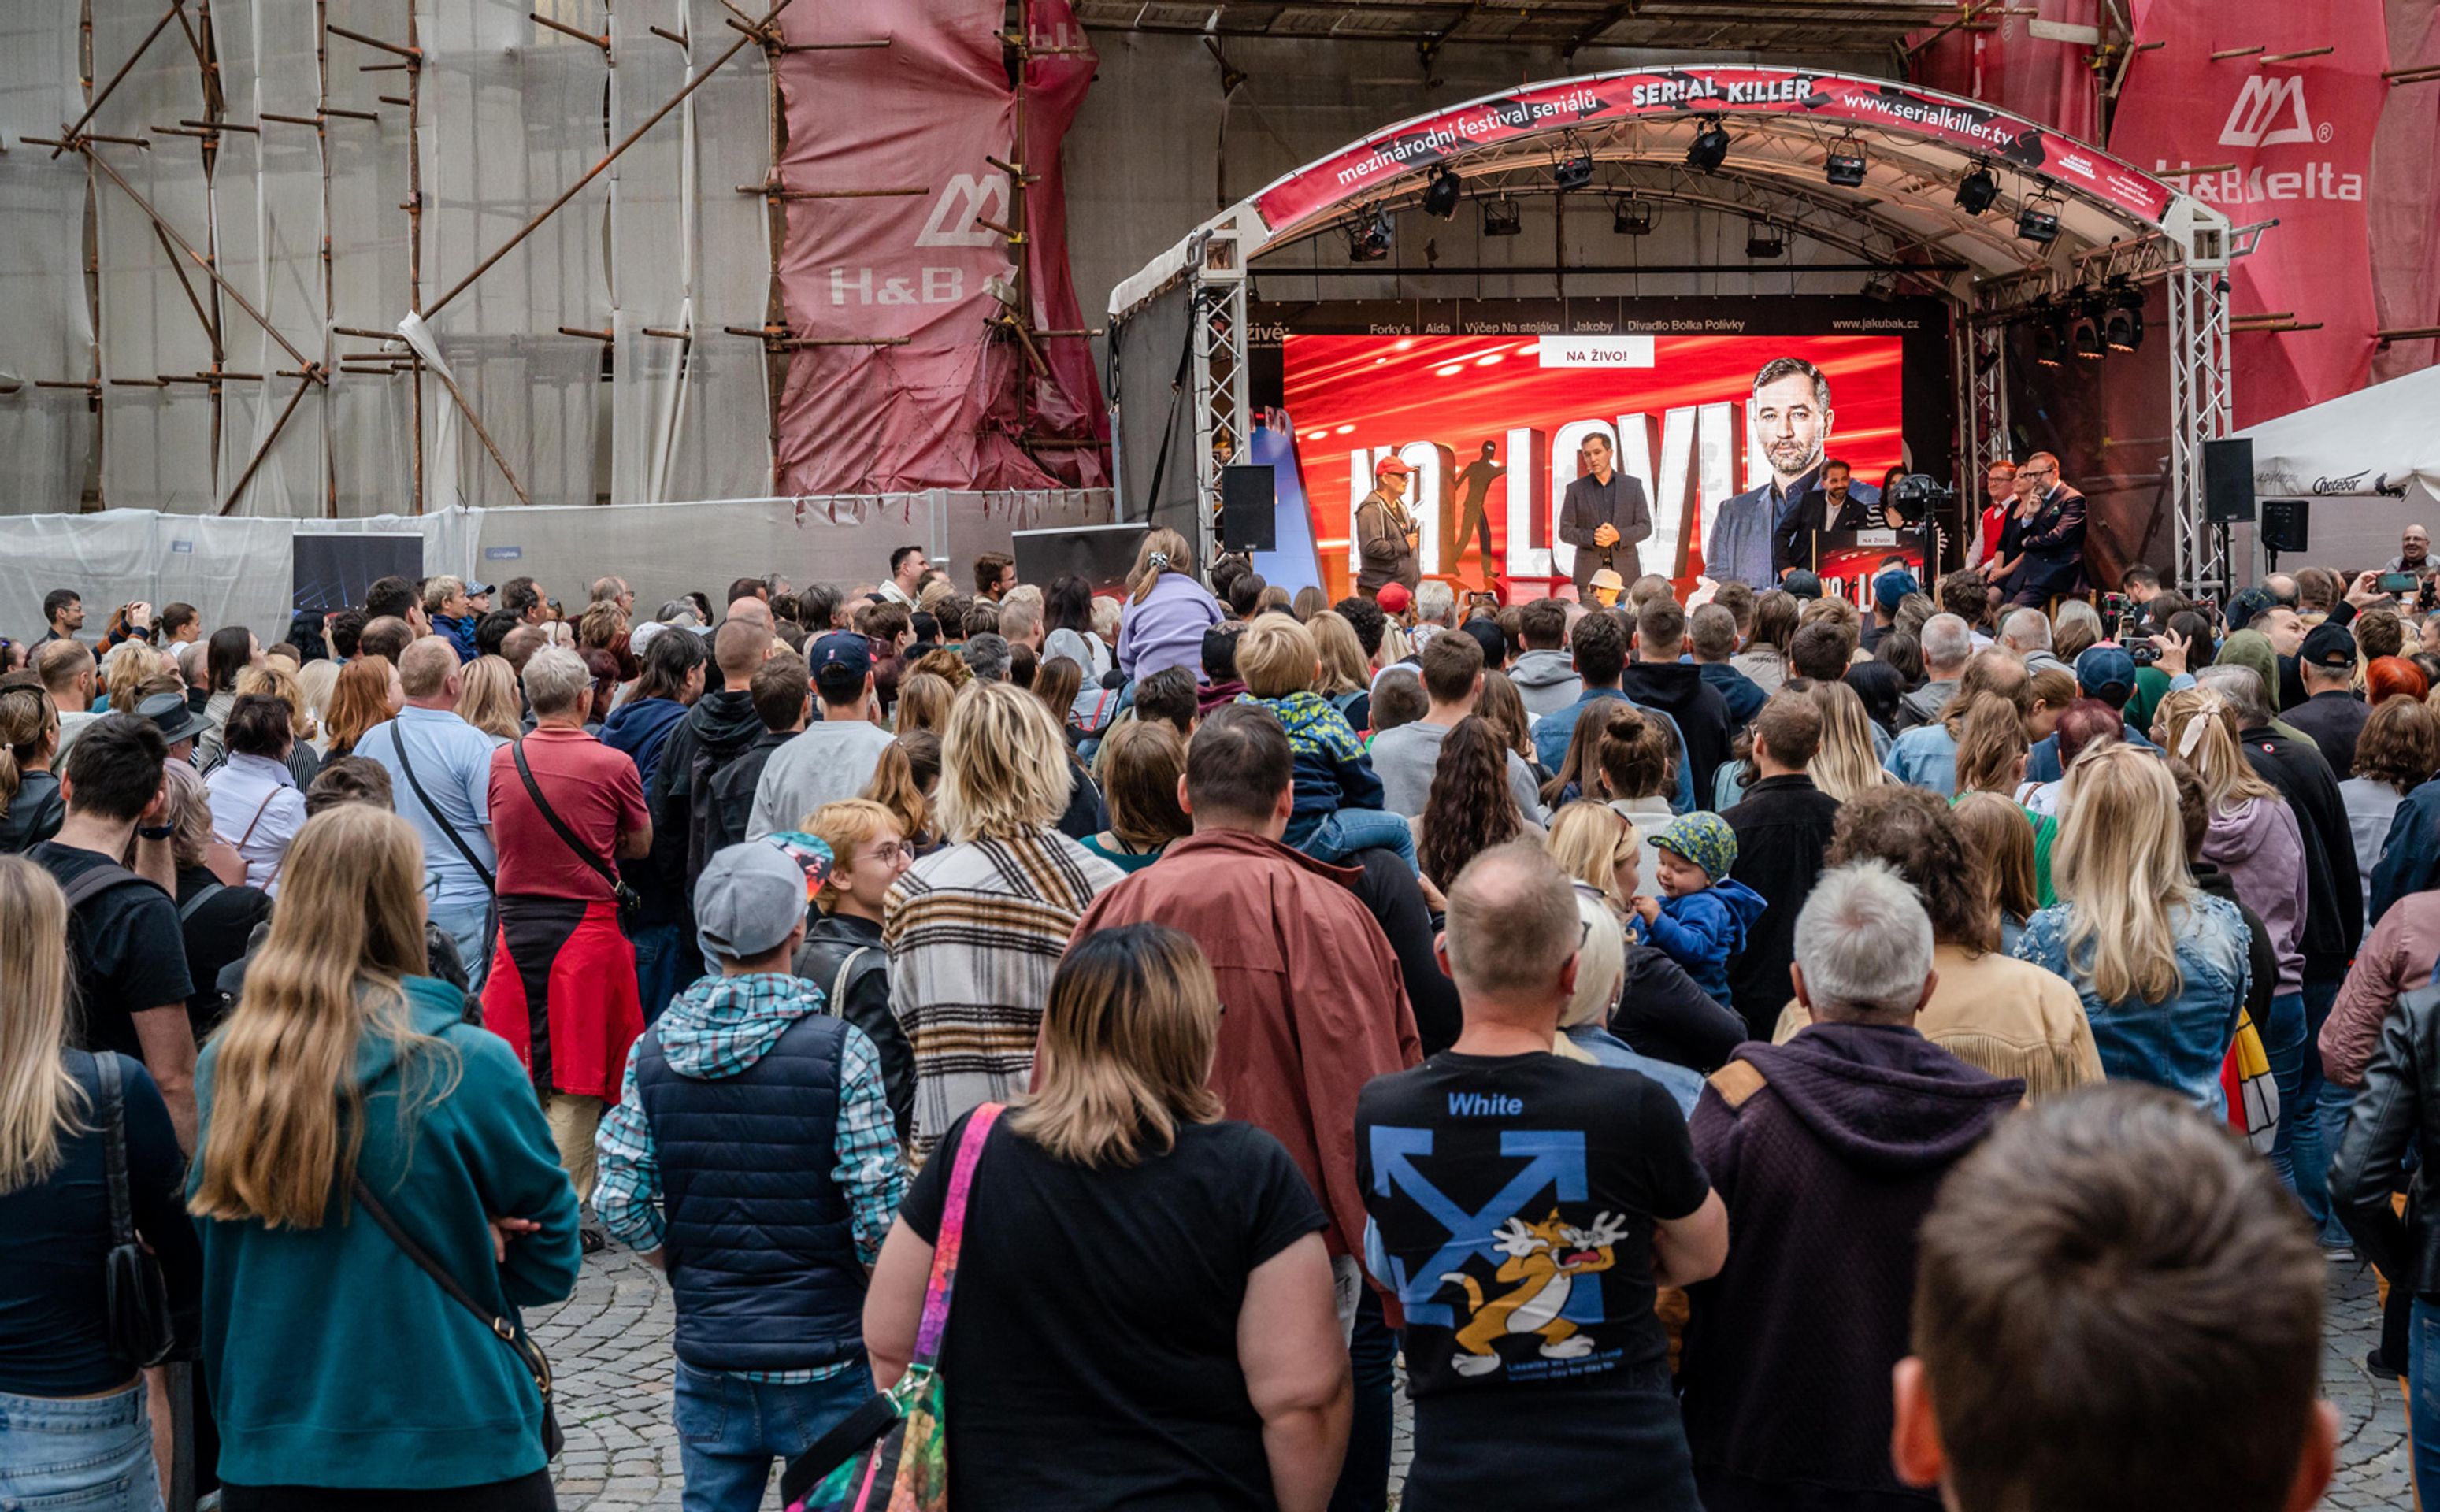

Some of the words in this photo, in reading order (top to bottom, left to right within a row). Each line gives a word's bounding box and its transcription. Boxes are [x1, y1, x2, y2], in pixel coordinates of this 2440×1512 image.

[1727, 79, 1811, 103] K!LLER
[1843, 94, 2014, 146] www.serialkiller.tv
[1337, 124, 1457, 185] mezinárodní
[1457, 102, 1529, 138] festival
[1532, 89, 1597, 120] seriálů
[831, 266, 964, 306] H&B
[1370, 324, 1411, 335] Forky's
[1425, 324, 1451, 334] Aida
[1465, 321, 1500, 334] Výčep
[1502, 322, 1517, 332] Na
[1519, 321, 1559, 334] stojáka
[1574, 321, 1614, 334] Jakoby
[1627, 320, 1669, 332] Divadlo
[1672, 320, 1703, 331] Bolka
[1705, 319, 1745, 332] Polívky
[1832, 317, 1920, 331] www.jakubak.cz
[1566, 351, 1586, 361] NA
[1591, 348, 1628, 361] ŽIVO!
[1448, 1091, 1524, 1117] White
